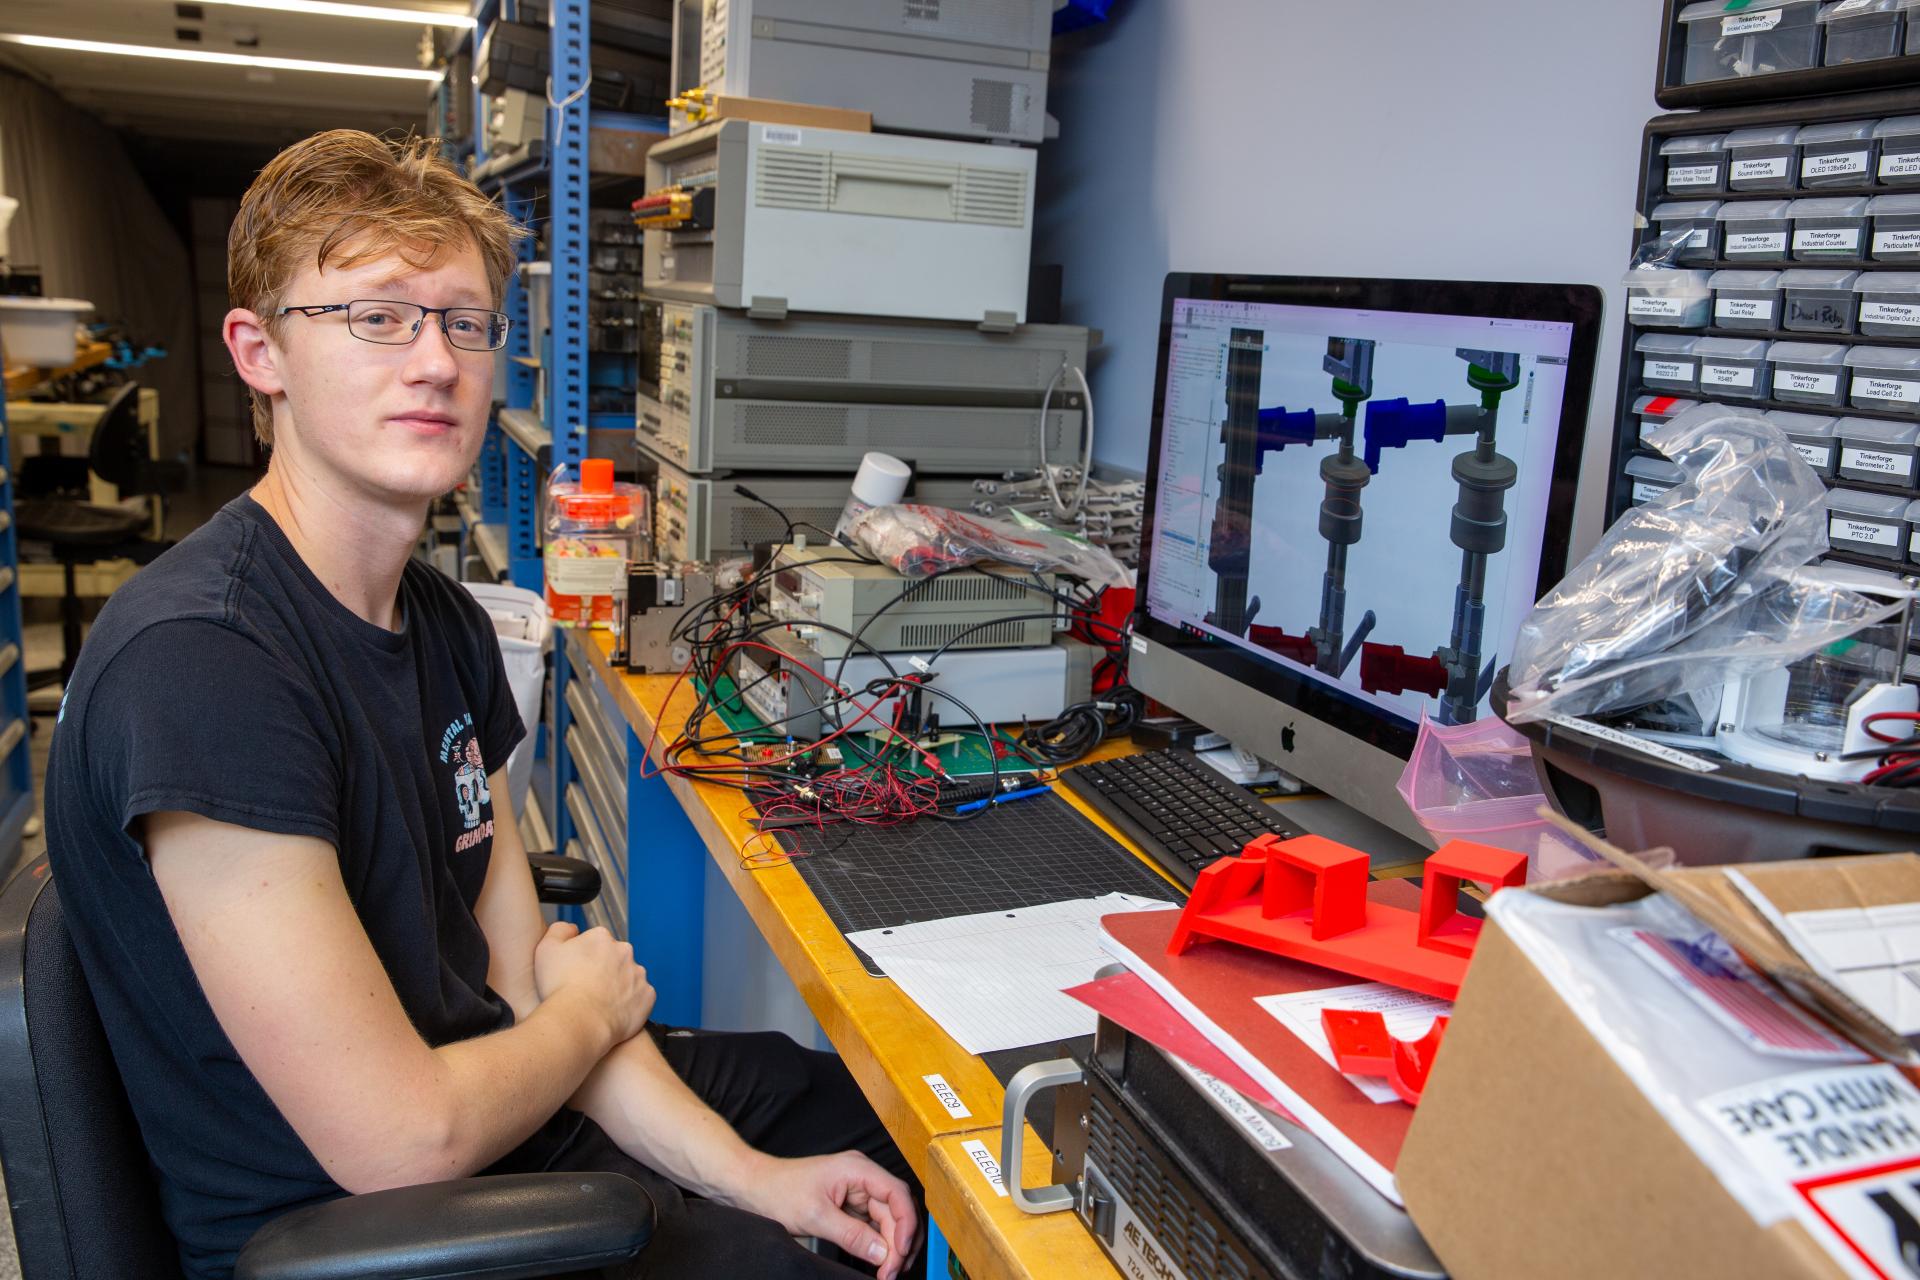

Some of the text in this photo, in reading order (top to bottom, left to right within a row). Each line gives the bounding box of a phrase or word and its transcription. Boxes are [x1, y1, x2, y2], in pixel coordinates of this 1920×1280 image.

[1742, 161, 1771, 169] Tinkerforge
[1818, 156, 1850, 165] Tinkerforge
[1810, 166, 1826, 174] OLED
[1827, 164, 1847, 172] 128x64
[1889, 165, 1904, 173] RGB
[1742, 236, 1770, 244] Tinkerforge
[1729, 301, 1757, 309] Tinkerforge
[1879, 305, 1912, 314] Tinkerforge
[1655, 363, 1680, 371] Tinkerforge
[1713, 368, 1739, 376] Tinkerforge
[1790, 374, 1820, 382] Tinkerforge
[1869, 381, 1903, 390] Tinkerforge
[1866, 388, 1881, 396] Load
[1860, 452, 1893, 463] Tinkerforge
[1855, 460, 1895, 471] Barometer 2.0
[1847, 523, 1880, 534] Tinkerforge
[440, 719, 465, 764] MENTAL
[1596, 725, 1657, 750] Acoustic
[1659, 749, 1711, 772] Mixing
[931, 1082, 961, 1109] ELEC9
[1719, 1089, 1819, 1136] CARE
[1243, 1114, 1282, 1147] Mixing
[1775, 1112, 1920, 1170] HANDLE
[1123, 1219, 1142, 1248] AE
